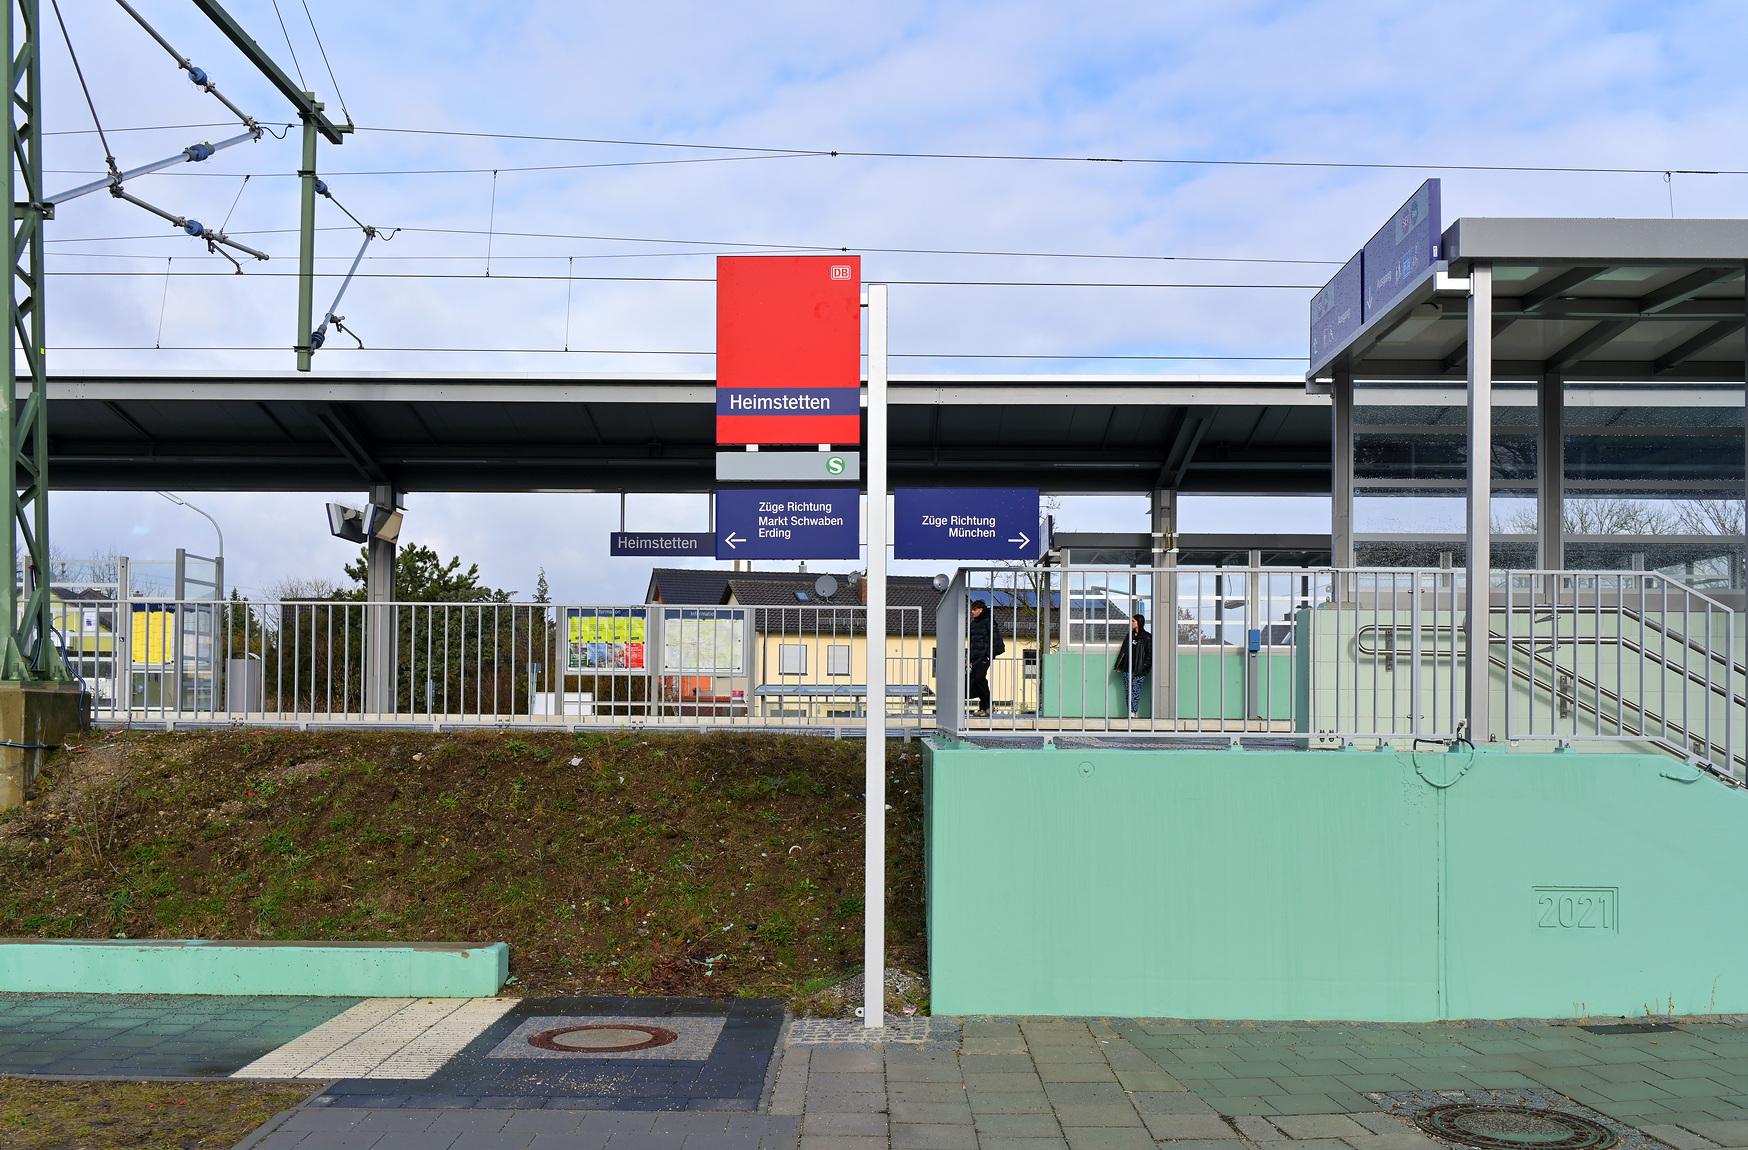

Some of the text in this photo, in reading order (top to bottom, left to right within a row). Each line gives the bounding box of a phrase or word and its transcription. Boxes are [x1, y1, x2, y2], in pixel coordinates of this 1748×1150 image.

[832, 267, 850, 279] DB
[729, 394, 831, 410] Heimstetten
[828, 457, 844, 475] S
[758, 501, 832, 514] Züge Richtung
[758, 516, 844, 526] Markt Schwaben
[921, 515, 996, 528] Züge Richtung
[758, 528, 791, 540] Erding
[948, 528, 996, 538] München
[618, 537, 698, 550] Heimstetten
[1537, 894, 1610, 929] 2021
